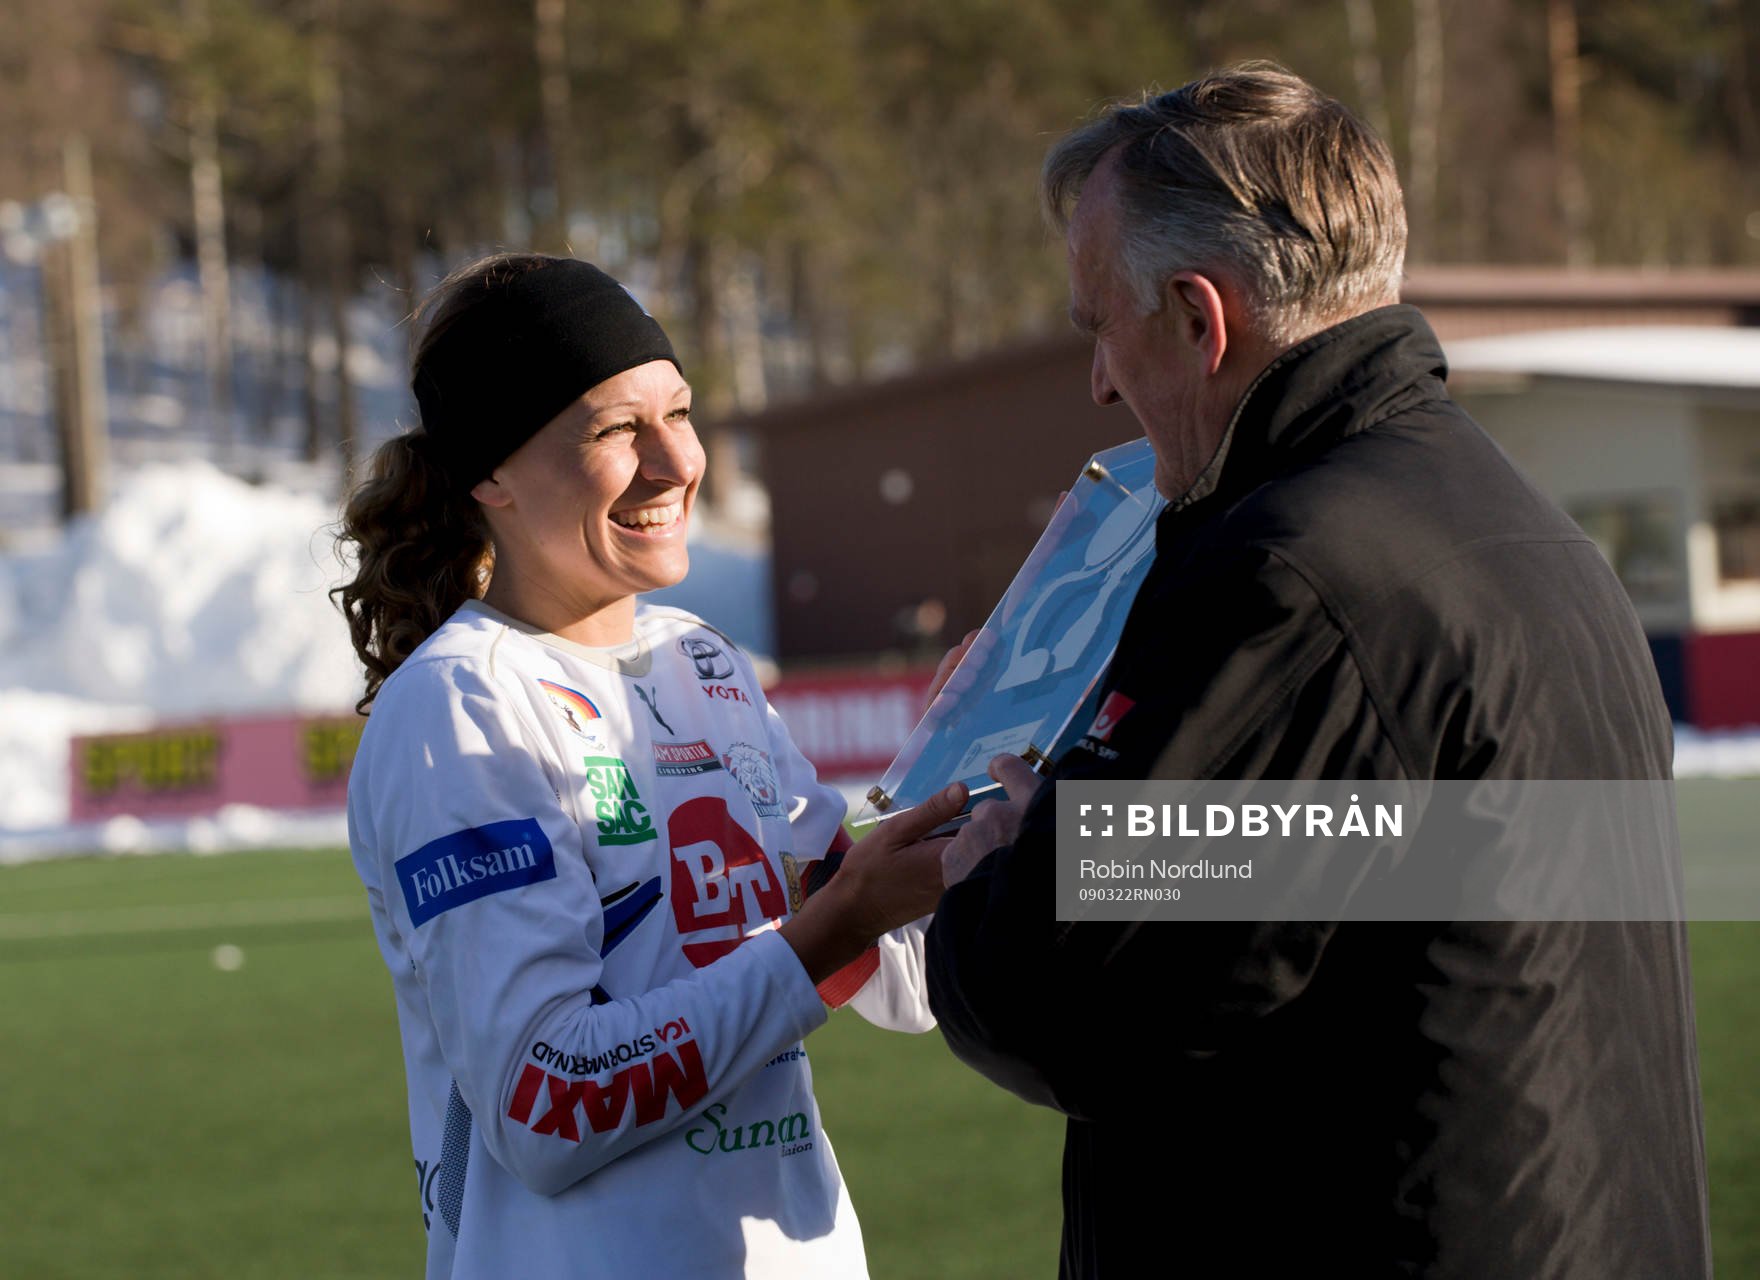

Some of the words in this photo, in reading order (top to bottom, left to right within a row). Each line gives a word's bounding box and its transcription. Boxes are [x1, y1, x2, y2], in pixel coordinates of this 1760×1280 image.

[586, 767, 640, 801] SAN
[595, 800, 651, 834] SAC
[410, 843, 537, 907] Folksam
[672, 840, 774, 937] BT
[508, 1039, 709, 1144] MAXI
